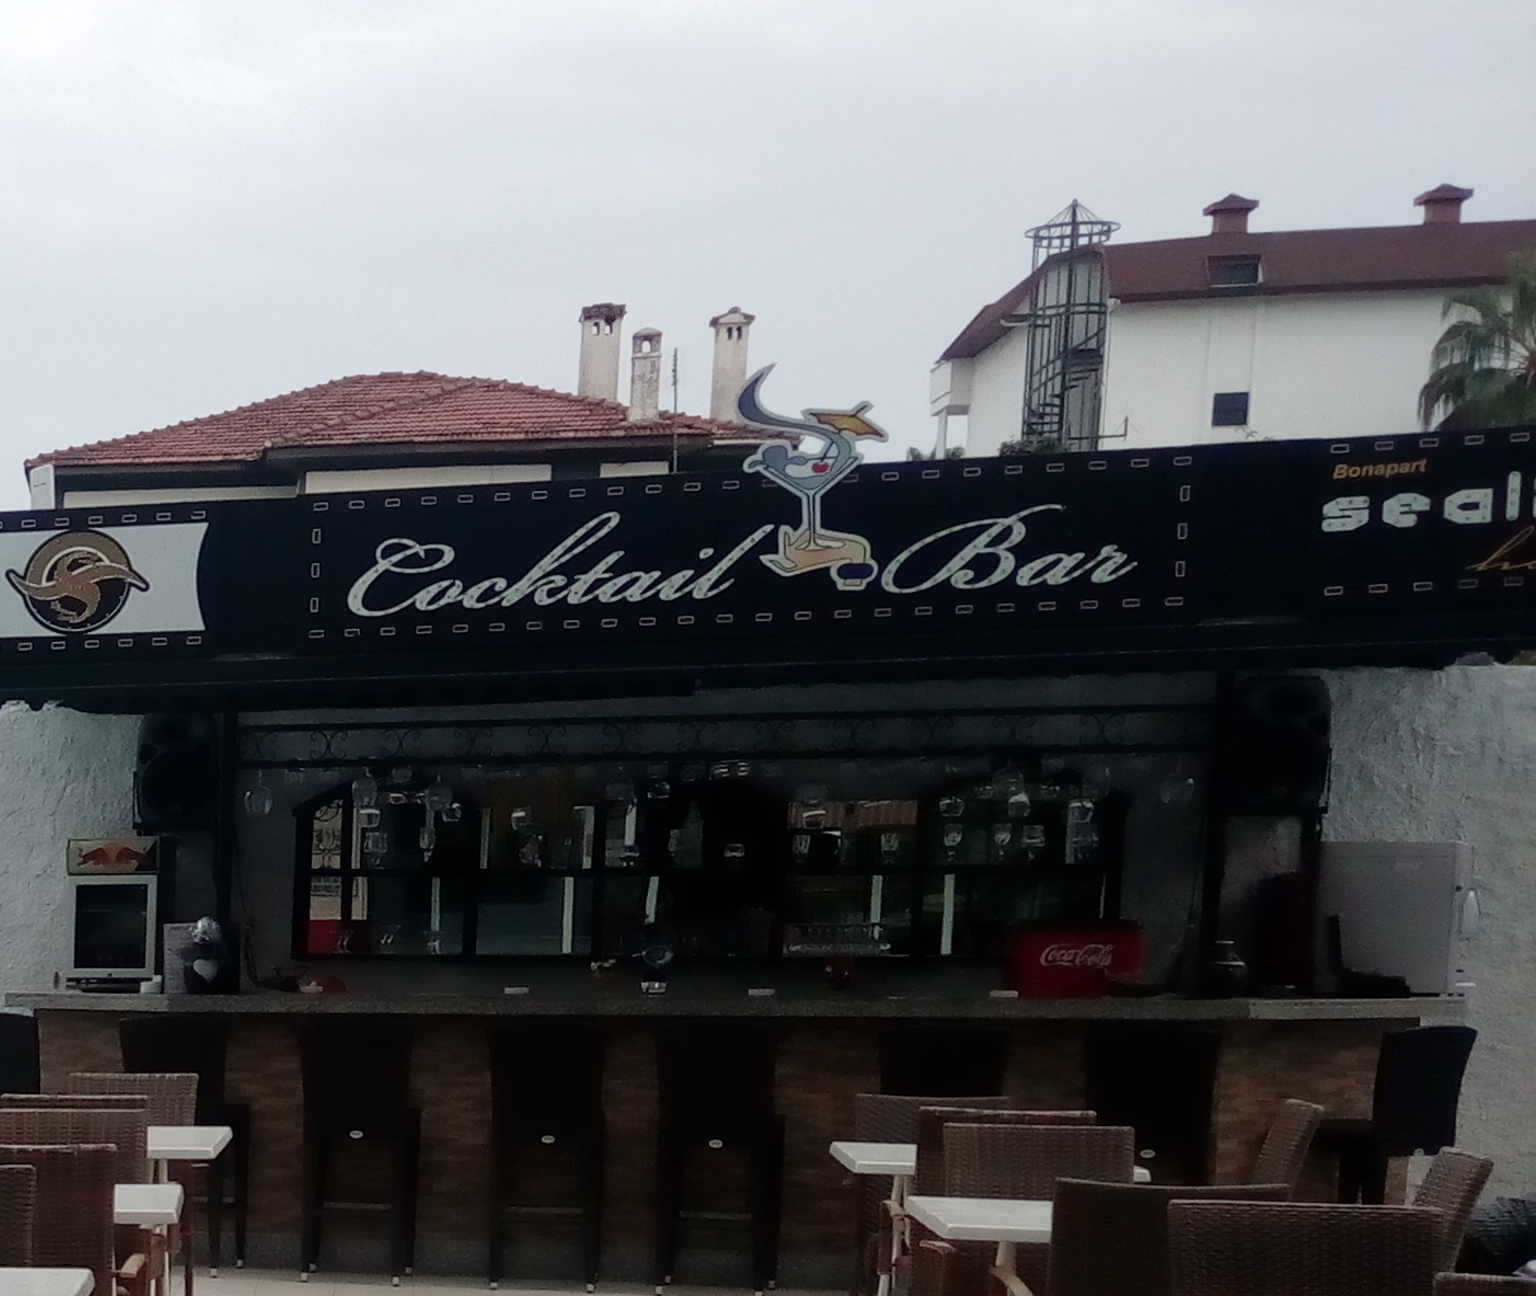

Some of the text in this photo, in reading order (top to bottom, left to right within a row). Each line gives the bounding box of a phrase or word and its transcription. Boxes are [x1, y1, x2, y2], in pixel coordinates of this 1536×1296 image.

[1332, 458, 1428, 480] Bonapart
[1321, 470, 1536, 533] seal
[347, 503, 1139, 617] Cocktail Bar
